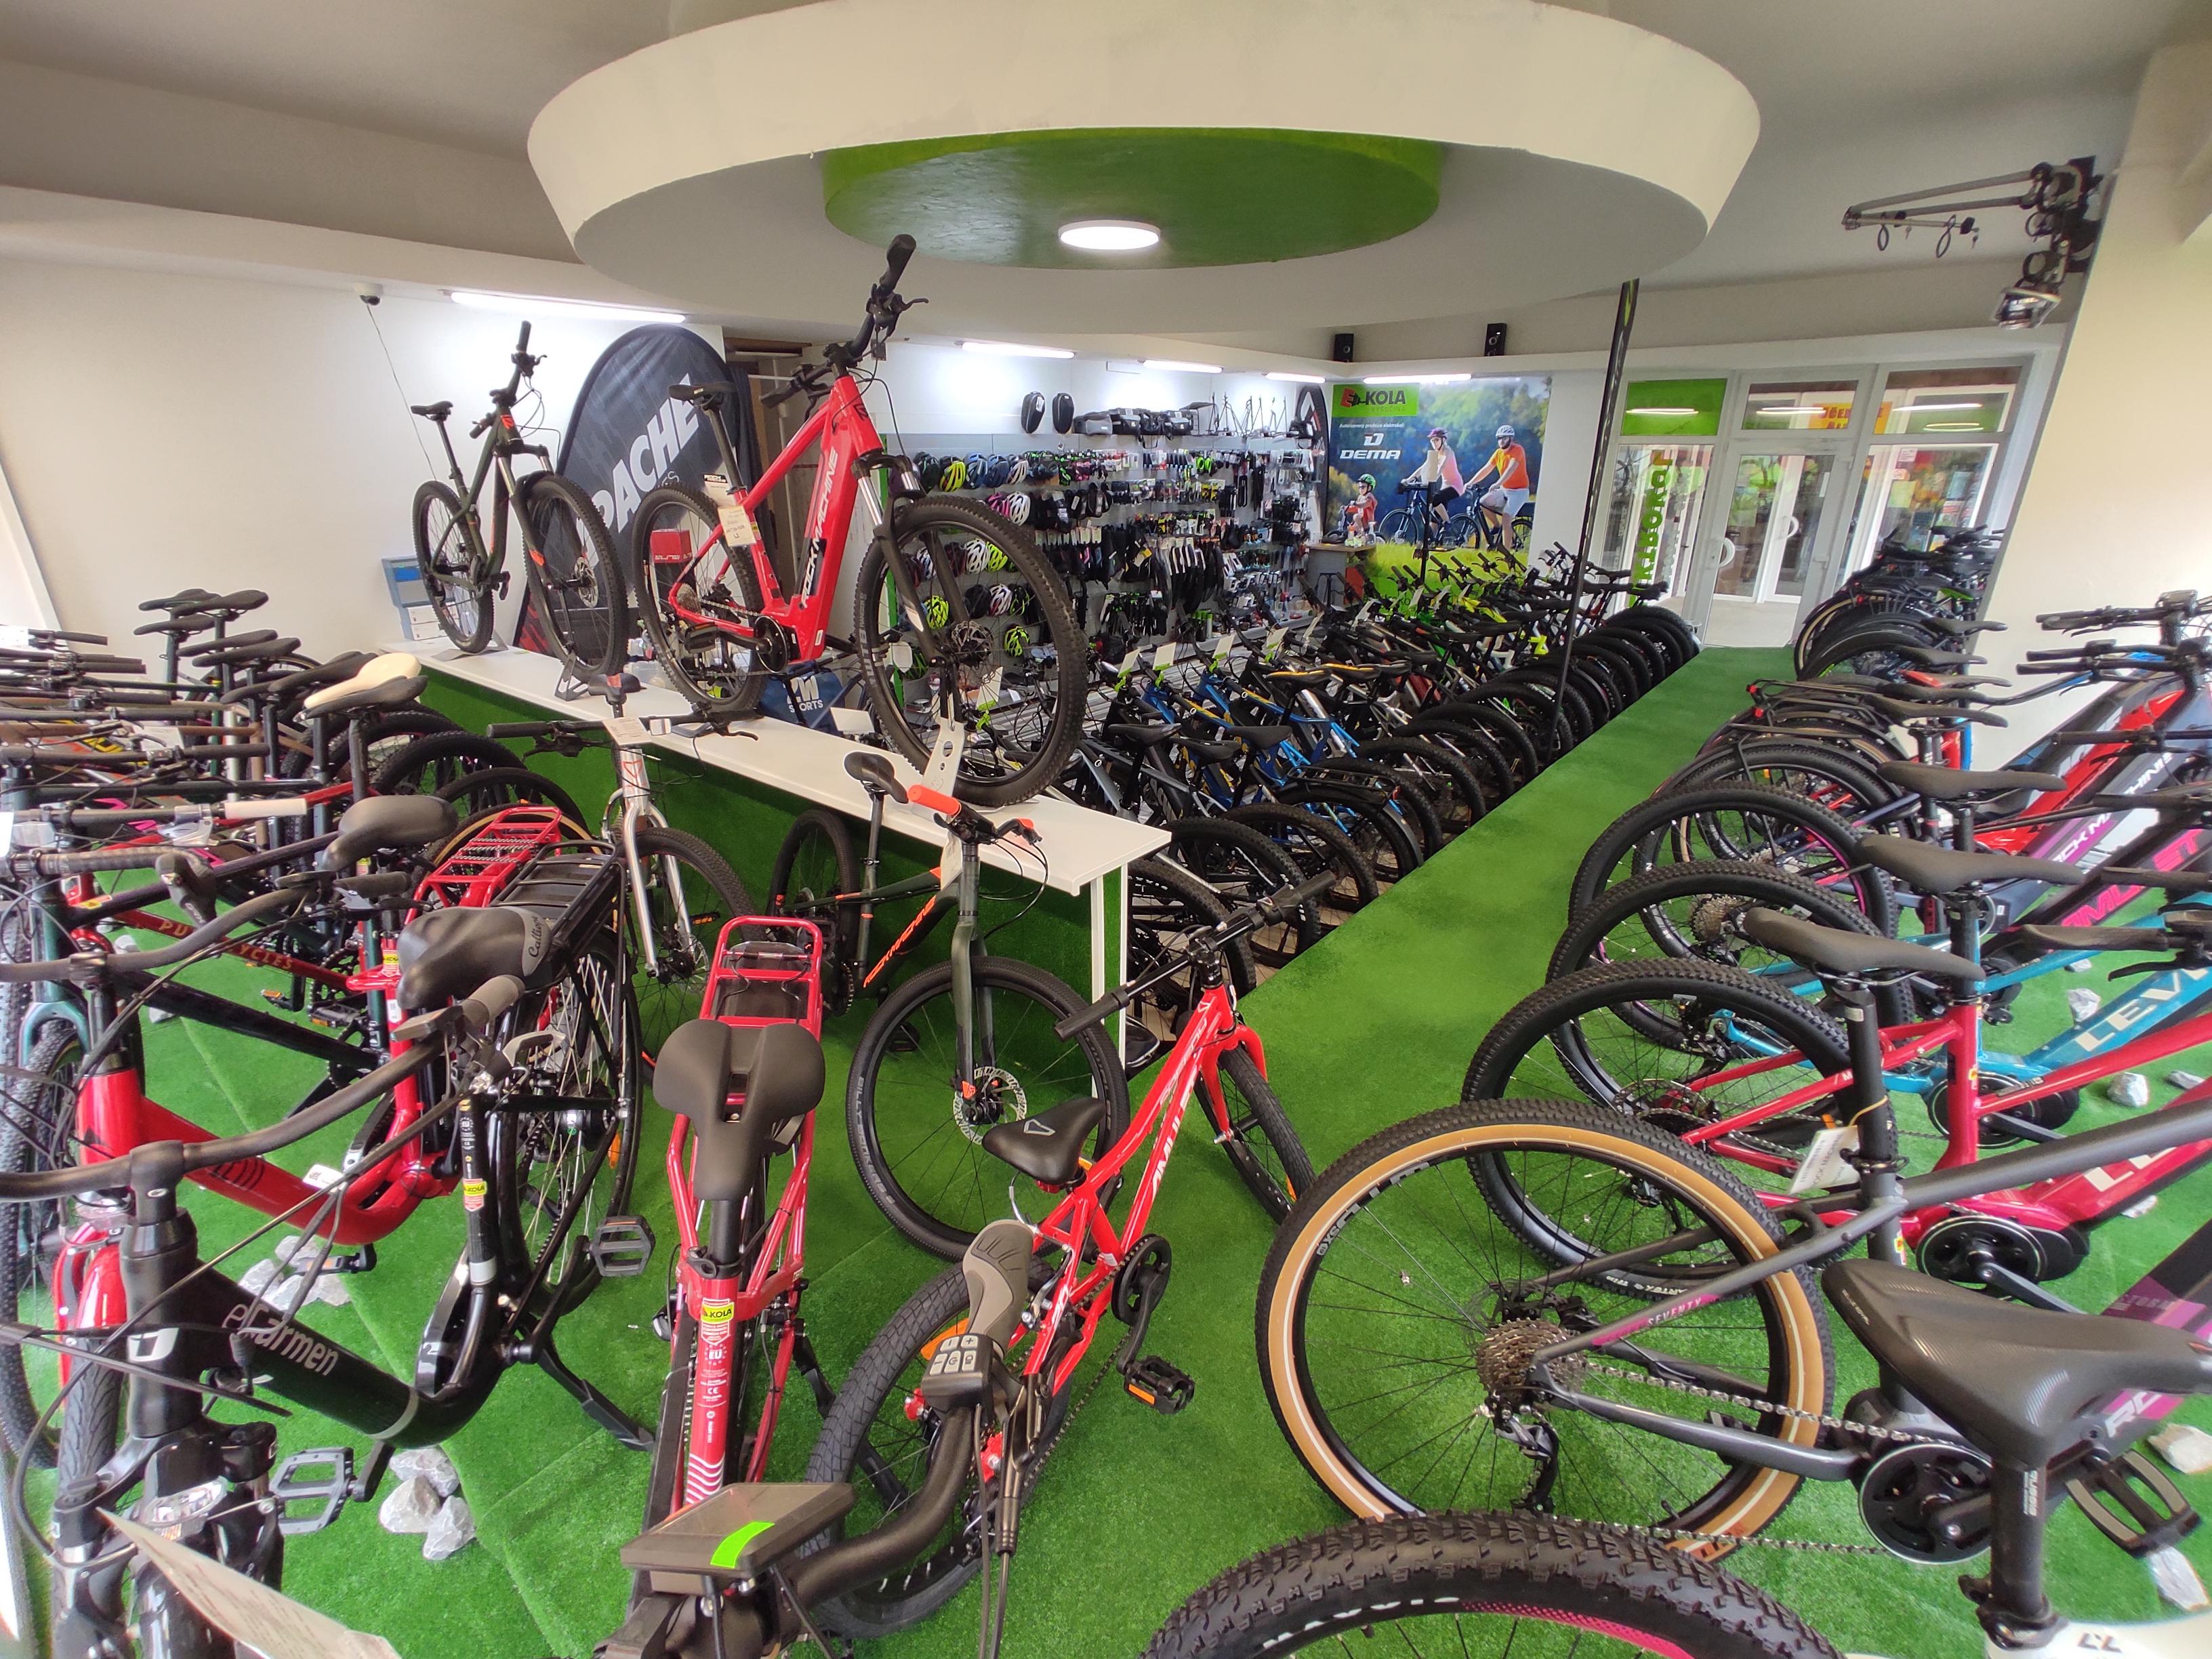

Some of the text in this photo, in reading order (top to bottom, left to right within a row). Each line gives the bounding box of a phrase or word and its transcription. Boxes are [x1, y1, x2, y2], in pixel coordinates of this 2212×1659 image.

[1339, 449, 1401, 459] DEMA
[812, 449, 838, 550] MACHINE
[789, 700, 824, 713] SORTS
[239, 942, 293, 970] YCLES
[1647, 1297, 1702, 1326] SEVENTY
